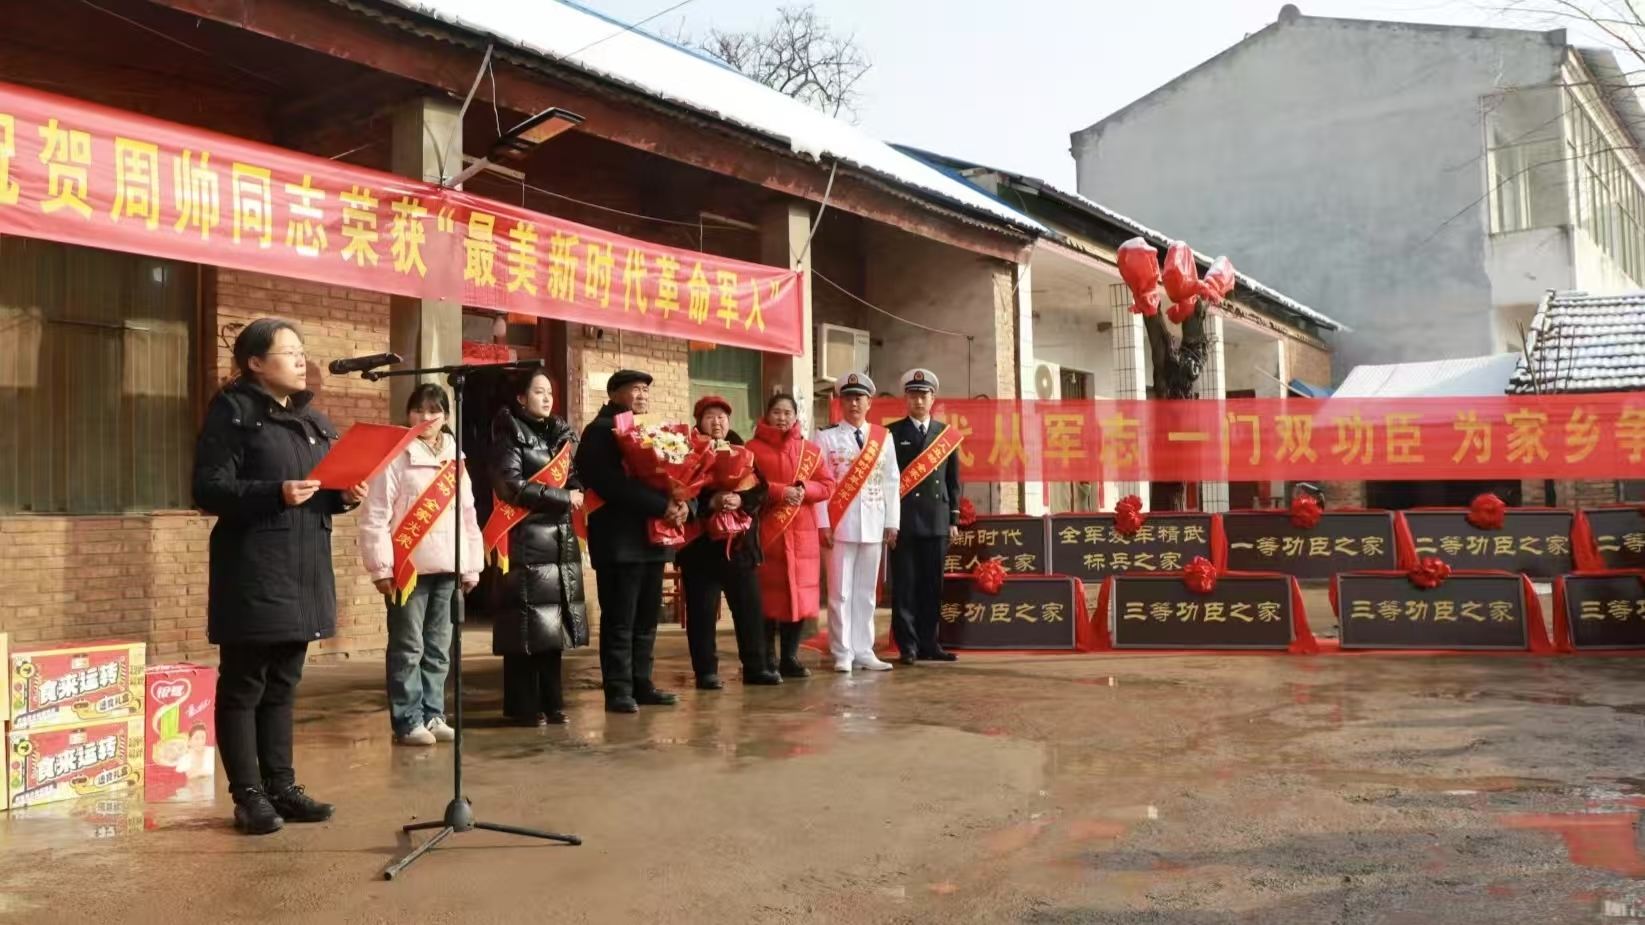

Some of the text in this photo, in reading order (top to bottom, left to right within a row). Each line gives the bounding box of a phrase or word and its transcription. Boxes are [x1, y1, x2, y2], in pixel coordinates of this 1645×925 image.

[881, 411, 1140, 467] 代从军志
[1168, 410, 1425, 465] 一门双功臣
[395, 496, 441, 550] 全家光荣
[1230, 535, 1385, 557] 一等功臣之家
[1415, 534, 1570, 557] 二等功臣之家
[1083, 551, 1183, 571] 标兵之家
[1123, 601, 1282, 623] 三等功臣之家
[1350, 599, 1515, 622] 三等功臣之家
